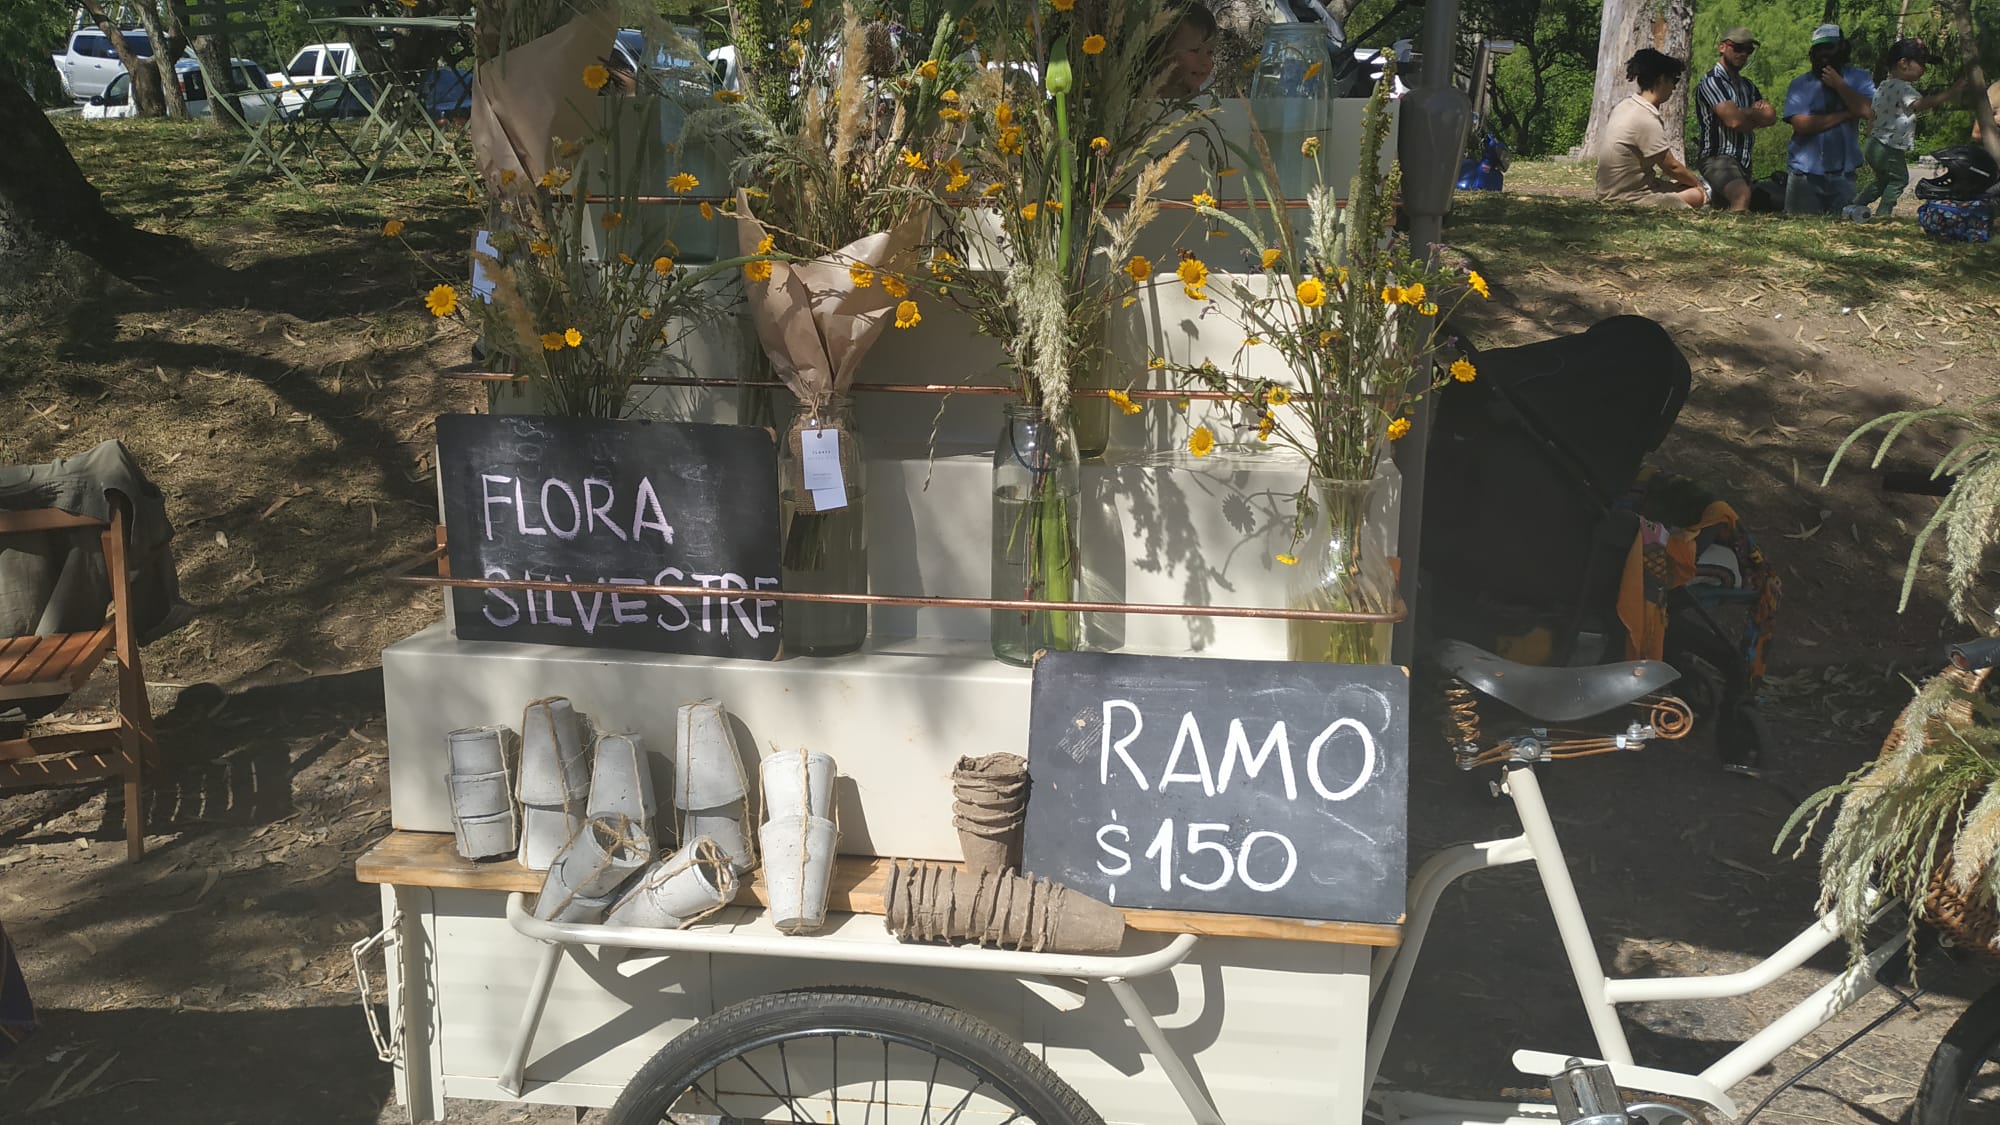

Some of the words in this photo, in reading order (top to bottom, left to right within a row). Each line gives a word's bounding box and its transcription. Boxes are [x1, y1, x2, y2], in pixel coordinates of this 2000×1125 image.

[481, 474, 674, 544] FLORA
[482, 566, 779, 640] SILVESTRE
[1099, 699, 1376, 801] RAMO
[1095, 808, 1298, 904] $150
